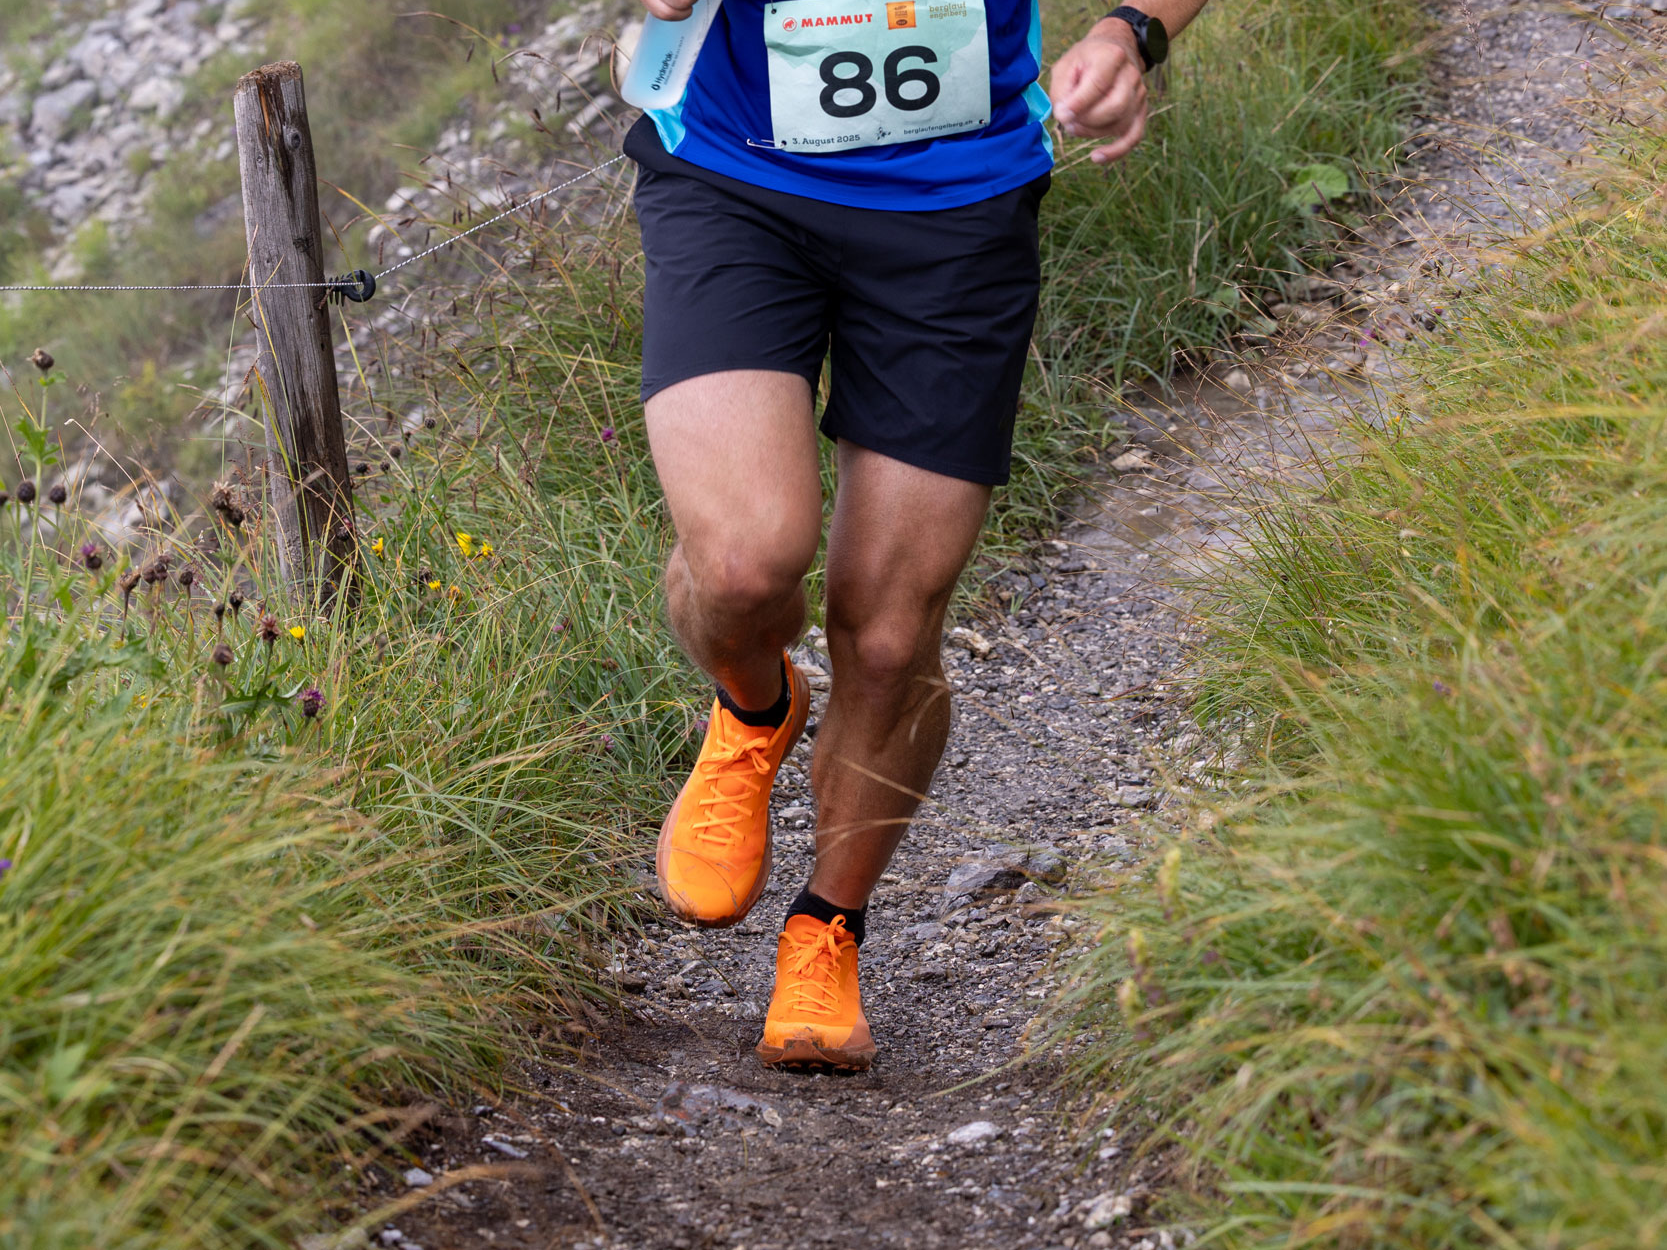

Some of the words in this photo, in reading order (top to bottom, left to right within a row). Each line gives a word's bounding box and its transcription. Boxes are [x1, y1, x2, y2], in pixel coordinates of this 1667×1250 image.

[929, 1, 967, 13] berglauf
[801, 13, 873, 28] MAMMUT
[929, 9, 967, 19] engelberg
[819, 45, 940, 118] 86
[904, 120, 973, 135] berglaufengelberg.ch
[792, 137, 800, 145] 3.
[802, 135, 835, 146] August
[836, 134, 861, 142] 2025
